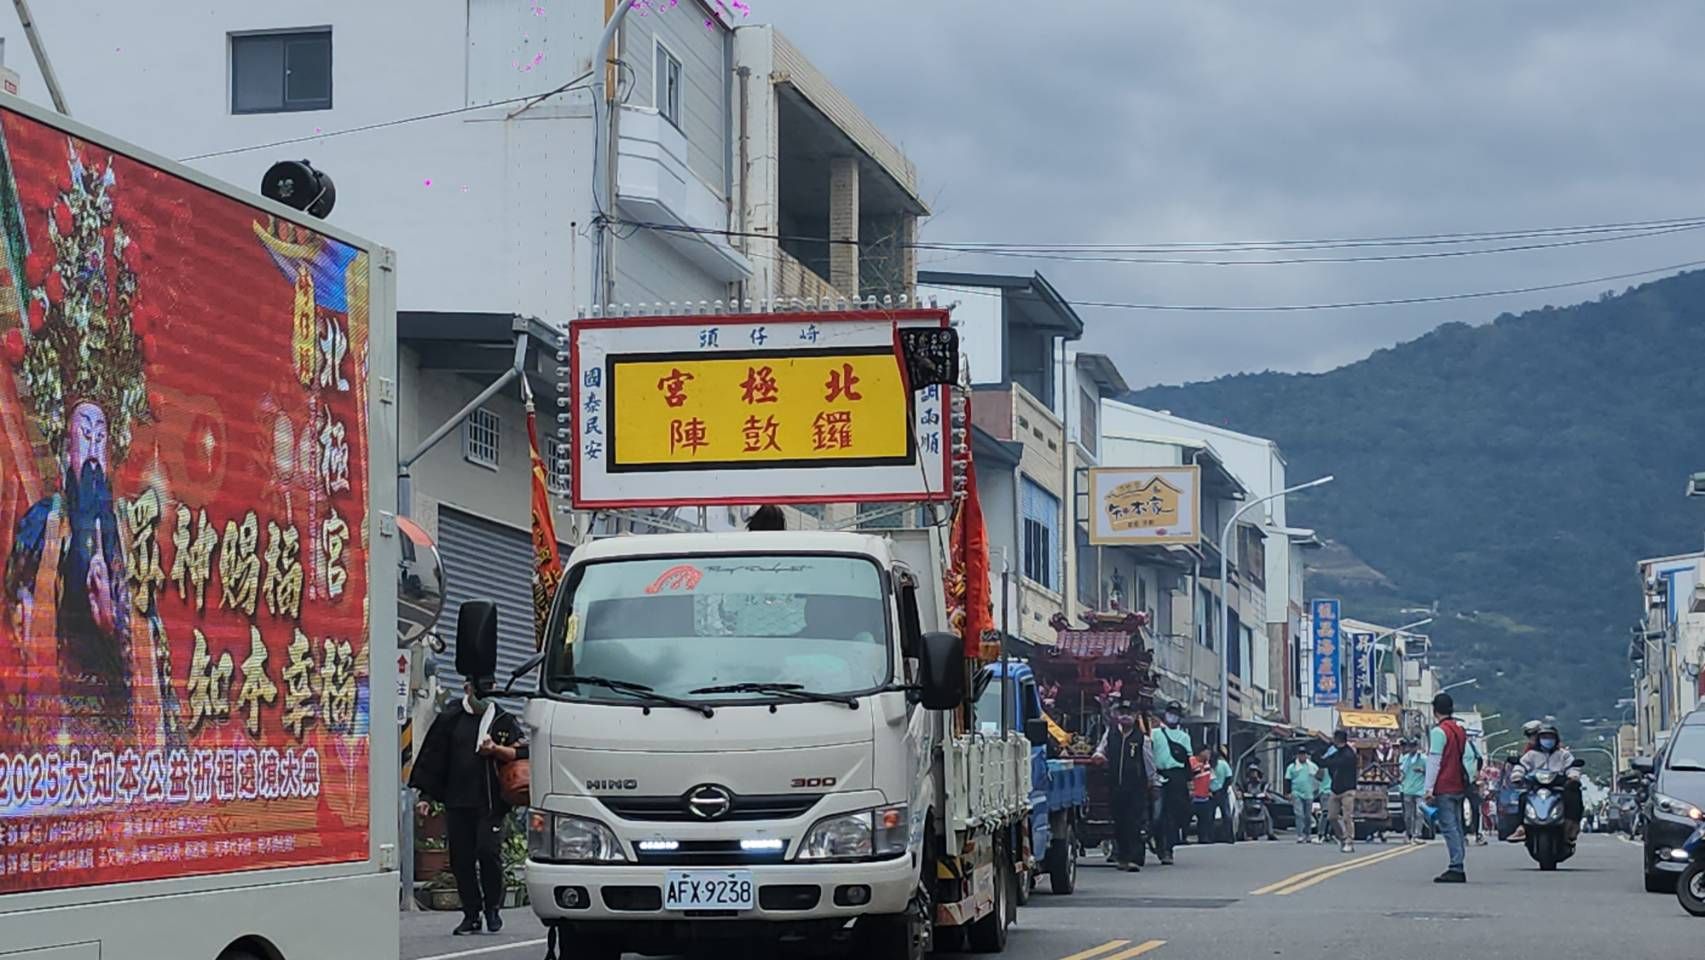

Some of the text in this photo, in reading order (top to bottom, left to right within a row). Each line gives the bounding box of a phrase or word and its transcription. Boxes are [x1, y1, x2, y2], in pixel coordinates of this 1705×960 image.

[657, 363, 863, 408] 北極宮
[584, 367, 602, 460] 國泰民安
[586, 779, 638, 790] HINO
[791, 777, 837, 788] 300
[667, 881, 751, 904] AFX-9238
